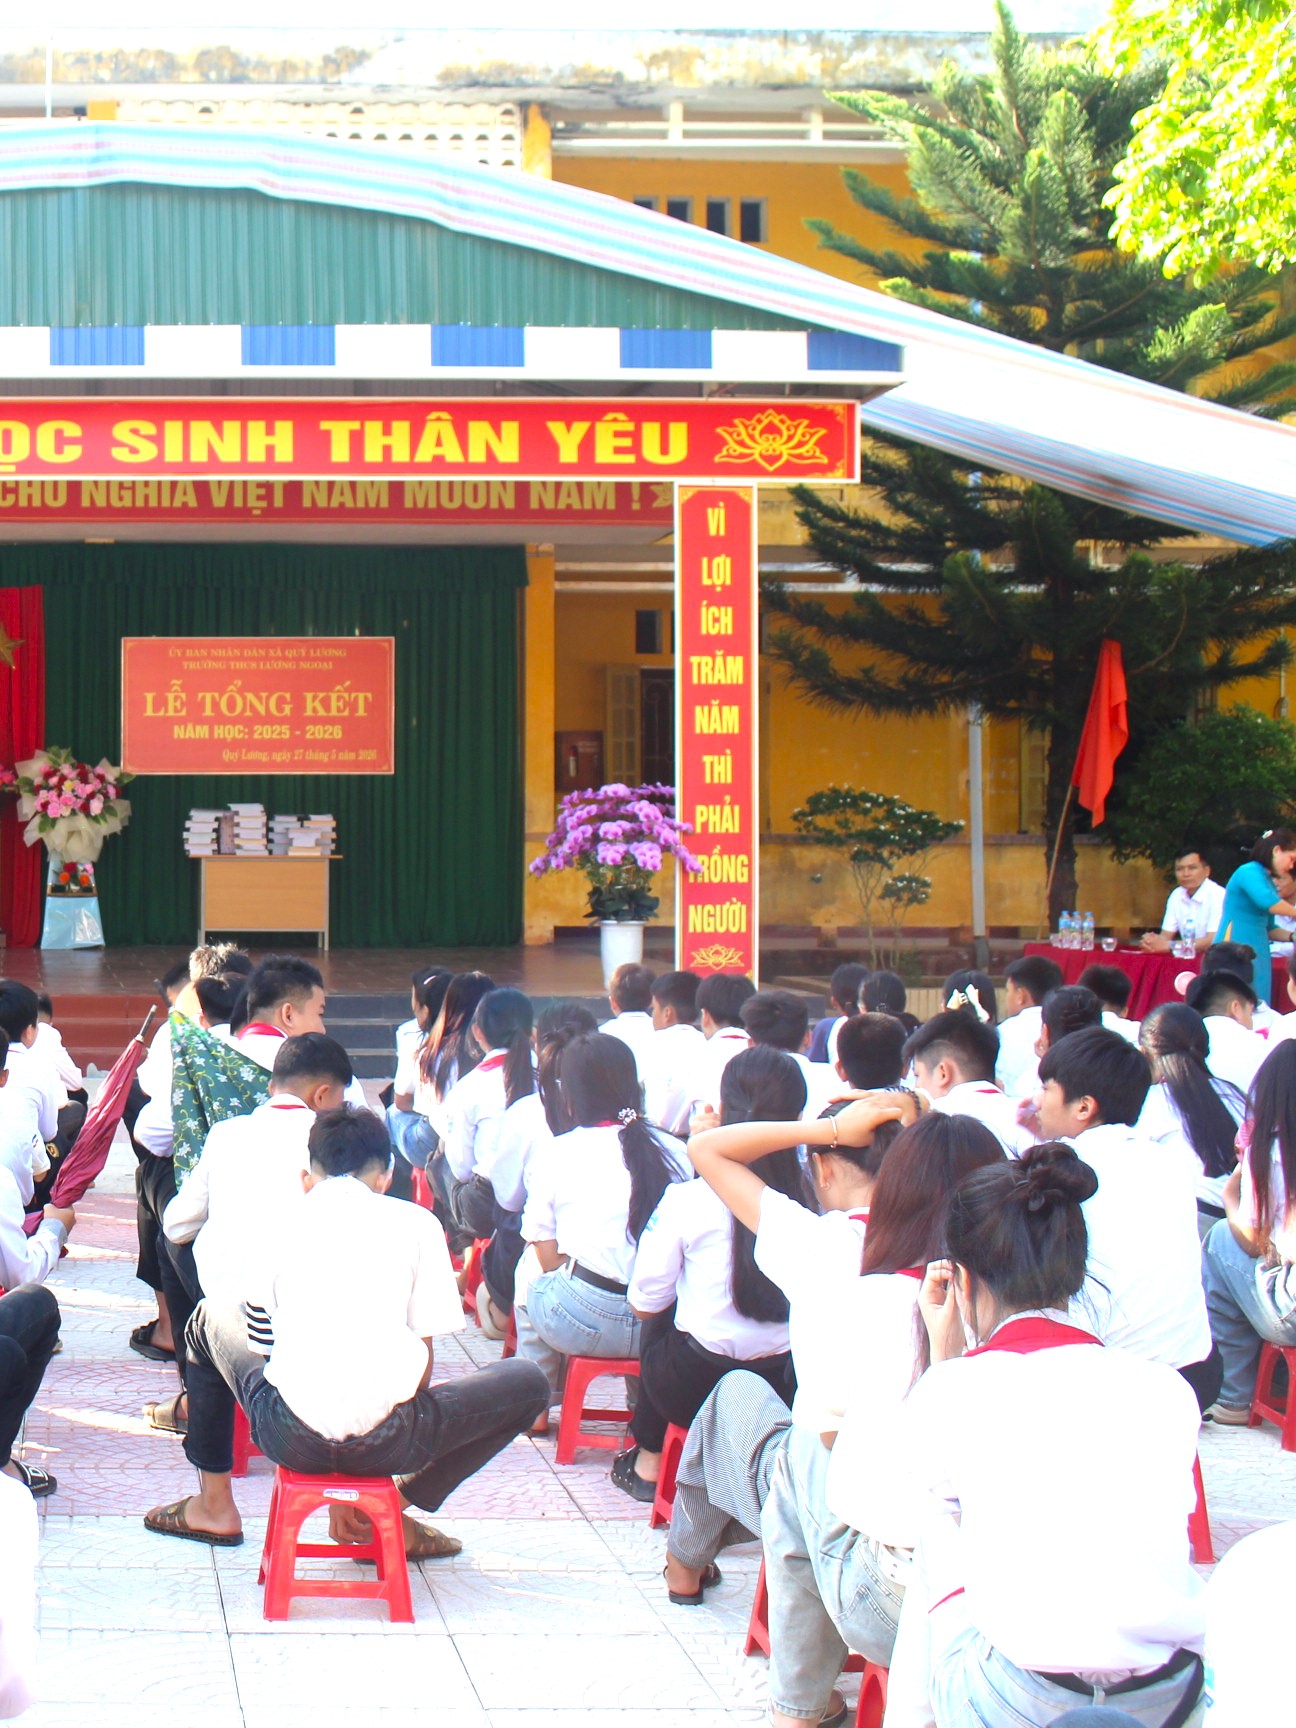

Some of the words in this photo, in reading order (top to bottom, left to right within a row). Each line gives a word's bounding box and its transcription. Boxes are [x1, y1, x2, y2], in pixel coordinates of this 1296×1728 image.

[111, 419, 293, 464] SINH
[320, 412, 520, 464] THÂN
[547, 412, 689, 465] YÊU
[707, 502, 725, 536] VÌ
[702, 554, 732, 592] LỢI
[701, 600, 733, 635] ÍCH
[186, 648, 208, 657] BAN
[690, 650, 744, 684] TRĂM
[143, 680, 187, 716] LỄ
[197, 680, 293, 716] TỔNG
[304, 681, 372, 717] KẾT
[173, 723, 210, 739] NĂM
[214, 724, 249, 742] HỌC:
[253, 724, 291, 740] 2025
[305, 724, 343, 740] 2026
[695, 700, 740, 735] NĂM
[702, 749, 733, 784] THÌ
[695, 795, 740, 834] PHẢI
[688, 898, 747, 933] NGƯỜI
